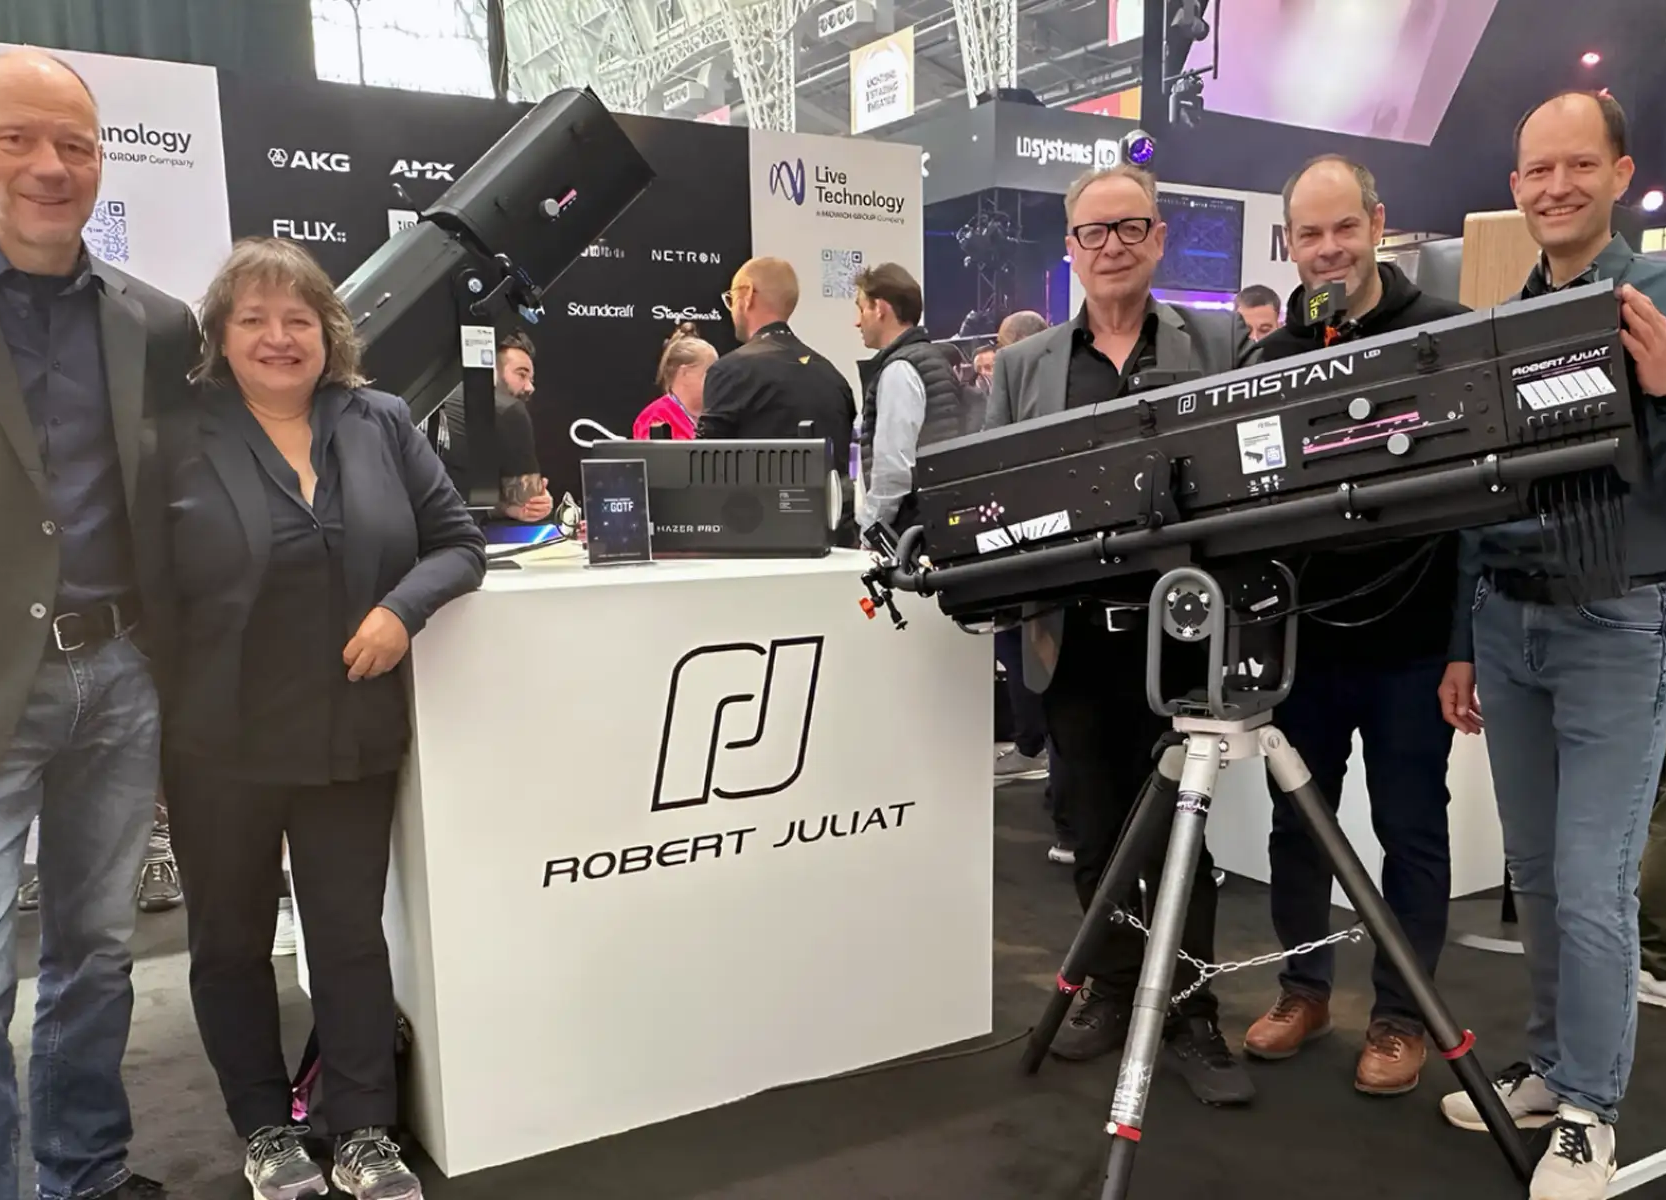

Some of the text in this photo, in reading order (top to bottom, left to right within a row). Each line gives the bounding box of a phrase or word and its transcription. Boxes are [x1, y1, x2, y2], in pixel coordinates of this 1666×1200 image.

[109, 152, 194, 168] GROUP Company
[290, 150, 351, 172] AKG
[389, 159, 455, 181] AMX
[815, 165, 847, 184] Live
[815, 185, 905, 213] Technology
[651, 249, 721, 264] NETRON
[1512, 357, 1565, 377] ROBERT
[1566, 346, 1610, 363] JULIAT
[1205, 355, 1354, 406] TRISTAN
[697, 525, 722, 533] PRO
[542, 801, 916, 888] ROBERT JULIAT
